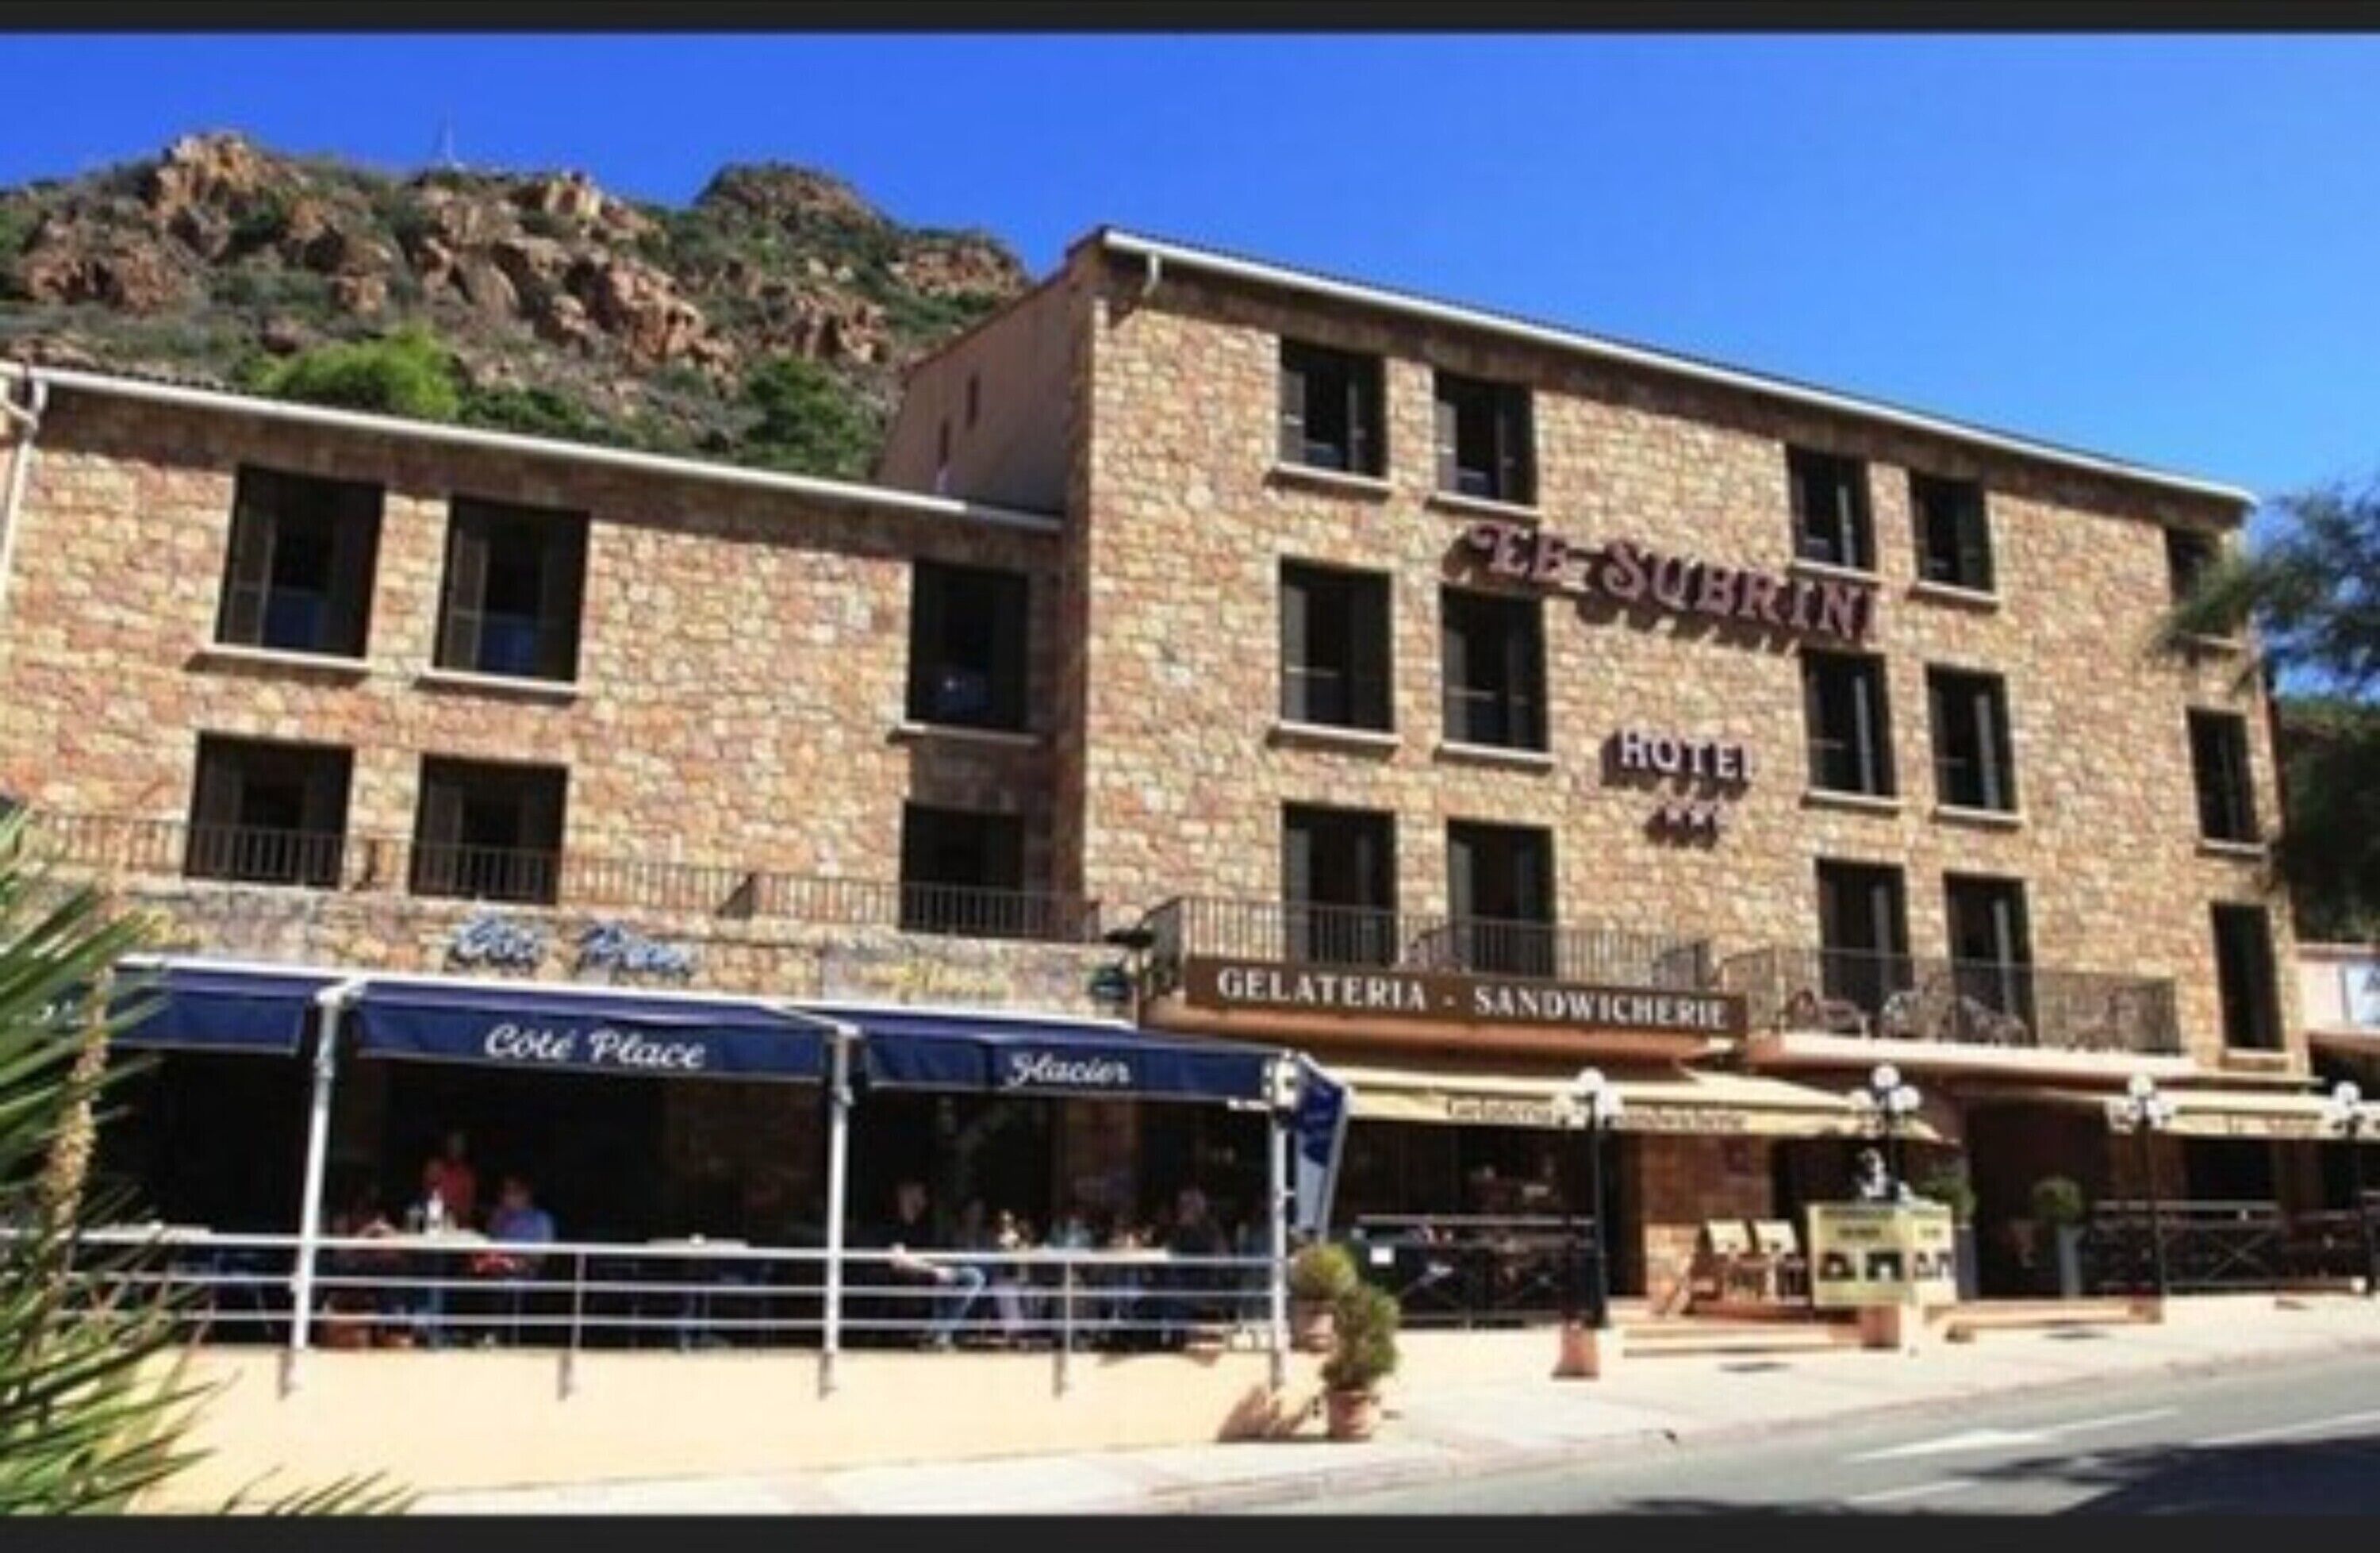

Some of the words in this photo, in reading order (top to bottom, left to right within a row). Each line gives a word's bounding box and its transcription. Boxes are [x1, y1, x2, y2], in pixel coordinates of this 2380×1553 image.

[1467, 521, 1568, 583] LE
[1217, 967, 1426, 1011] GELATERIA
[1473, 985, 1729, 1029] SANDWICHERIE
[589, 1028, 705, 1069] Place
